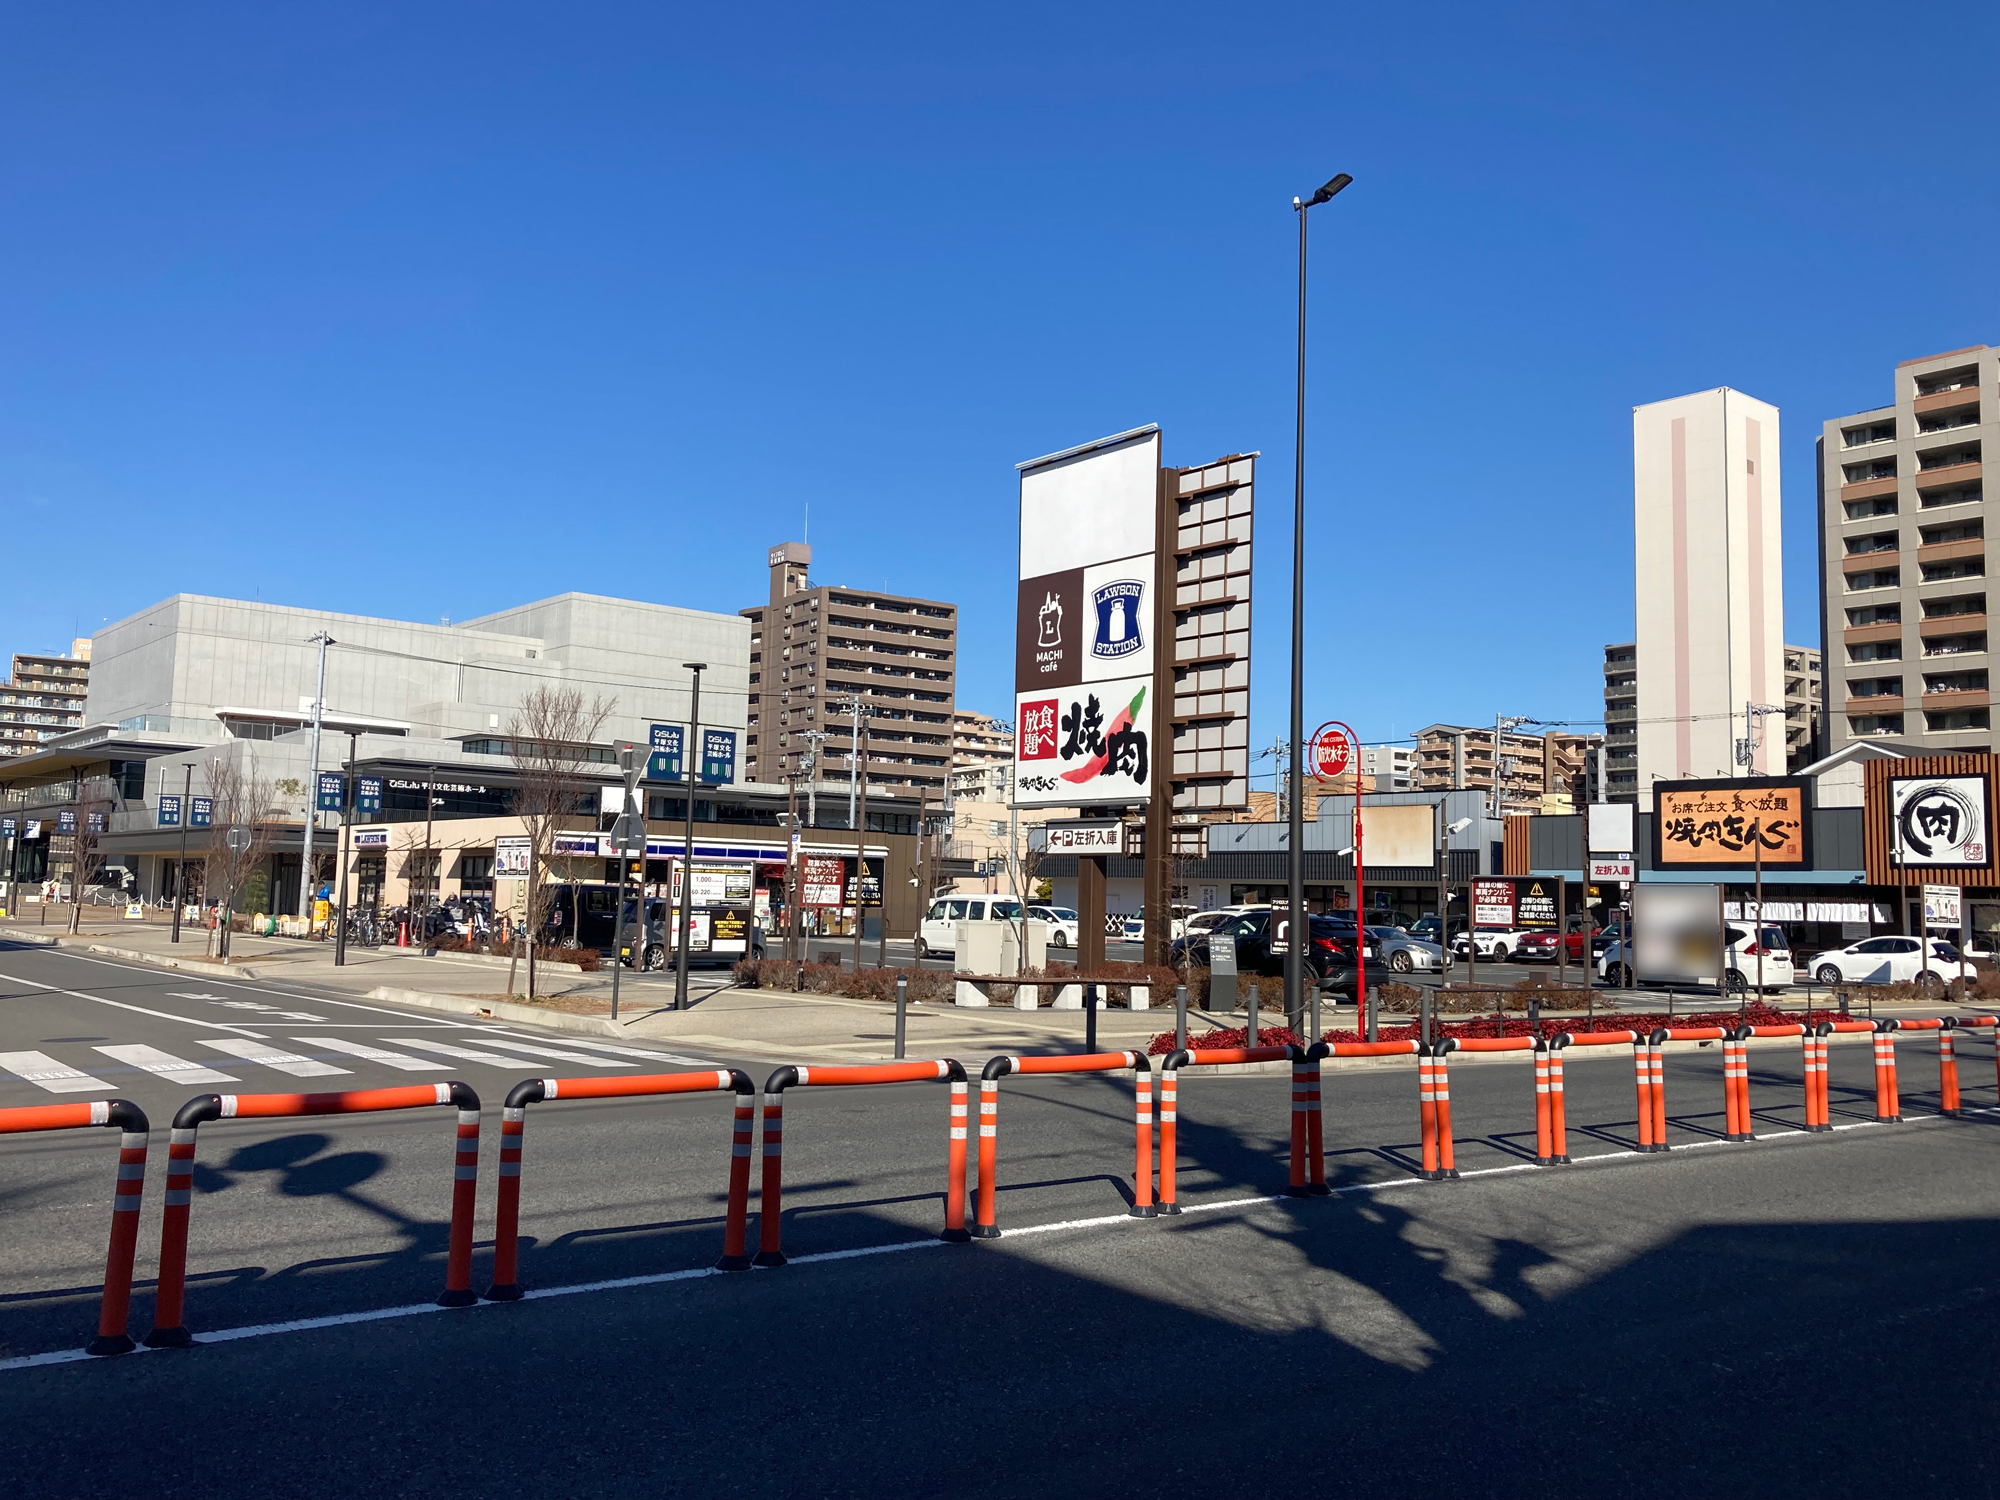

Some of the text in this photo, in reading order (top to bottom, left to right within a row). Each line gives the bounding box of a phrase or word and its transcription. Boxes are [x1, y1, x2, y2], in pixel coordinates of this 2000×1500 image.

[1096, 585, 1140, 604] LAWSON
[1046, 621, 1054, 634] L
[1095, 636, 1139, 655] STATION
[1036, 649, 1063, 663] MACHI
[1040, 661, 1058, 673] café
[1023, 709, 1040, 756] 放題
[1038, 704, 1055, 747] 食べ
[1060, 692, 1148, 785] 焼肉
[1318, 744, 1349, 763] 防火水そう
[1671, 797, 1789, 814] お席で注文 食べ放題
[1916, 801, 1960, 844] 肉
[1074, 830, 1117, 845] 左折入庫
[1665, 814, 1800, 851] 焼肉きんぐ
[1595, 865, 1631, 876] 左折入庫
[1478, 896, 1509, 904] が必要です
